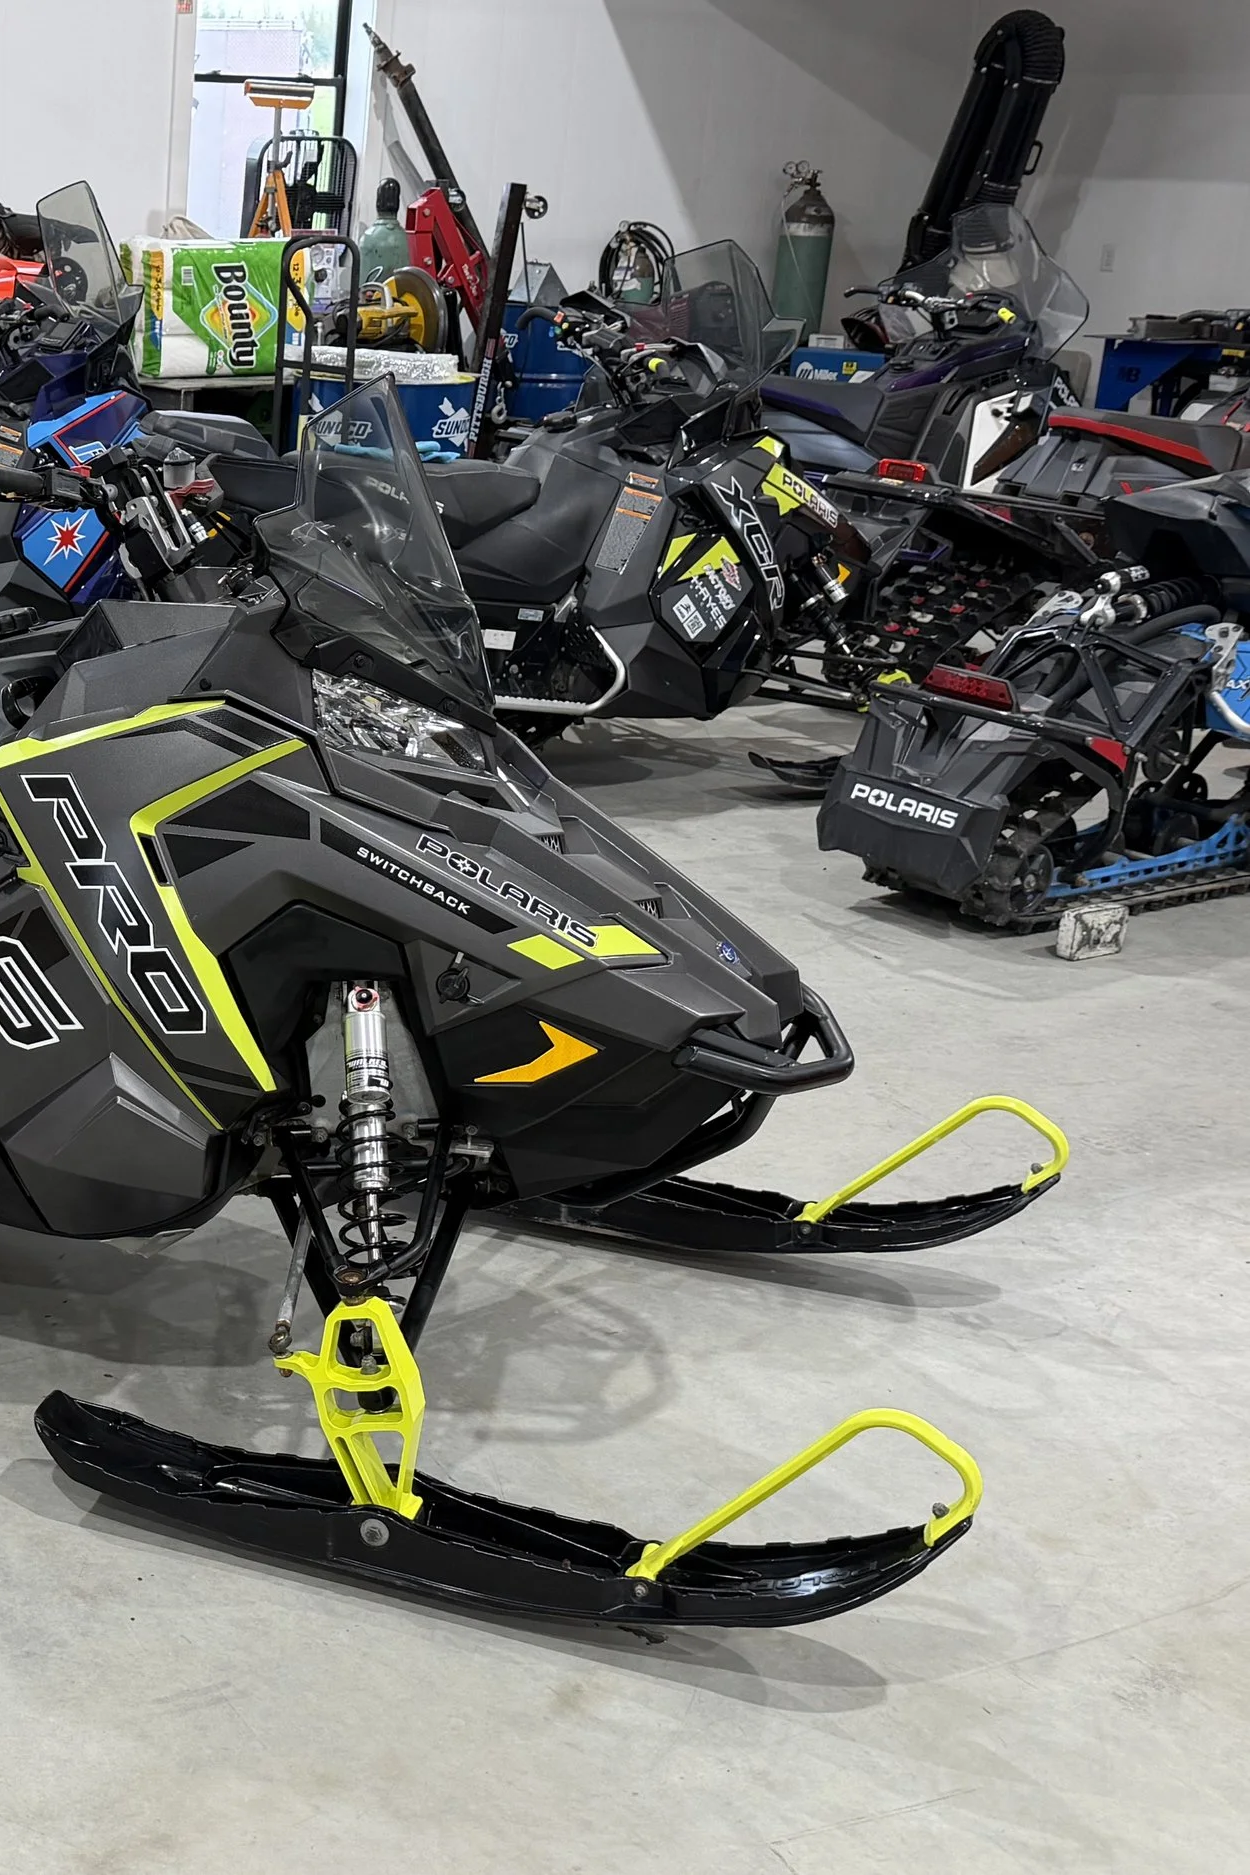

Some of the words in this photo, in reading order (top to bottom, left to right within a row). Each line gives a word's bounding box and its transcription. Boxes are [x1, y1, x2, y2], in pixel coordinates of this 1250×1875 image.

[211, 261, 260, 369] Bounty
[468, 357, 493, 443] PITTSBURGH
[711, 475, 785, 612] XCR
[782, 472, 839, 529] POLARIS
[690, 575, 728, 630] HAYES
[850, 783, 959, 829] POLARIS
[19, 773, 207, 1034] PRO
[356, 846, 471, 915] SWITCHBACK
[415, 833, 599, 949] POLARIS
